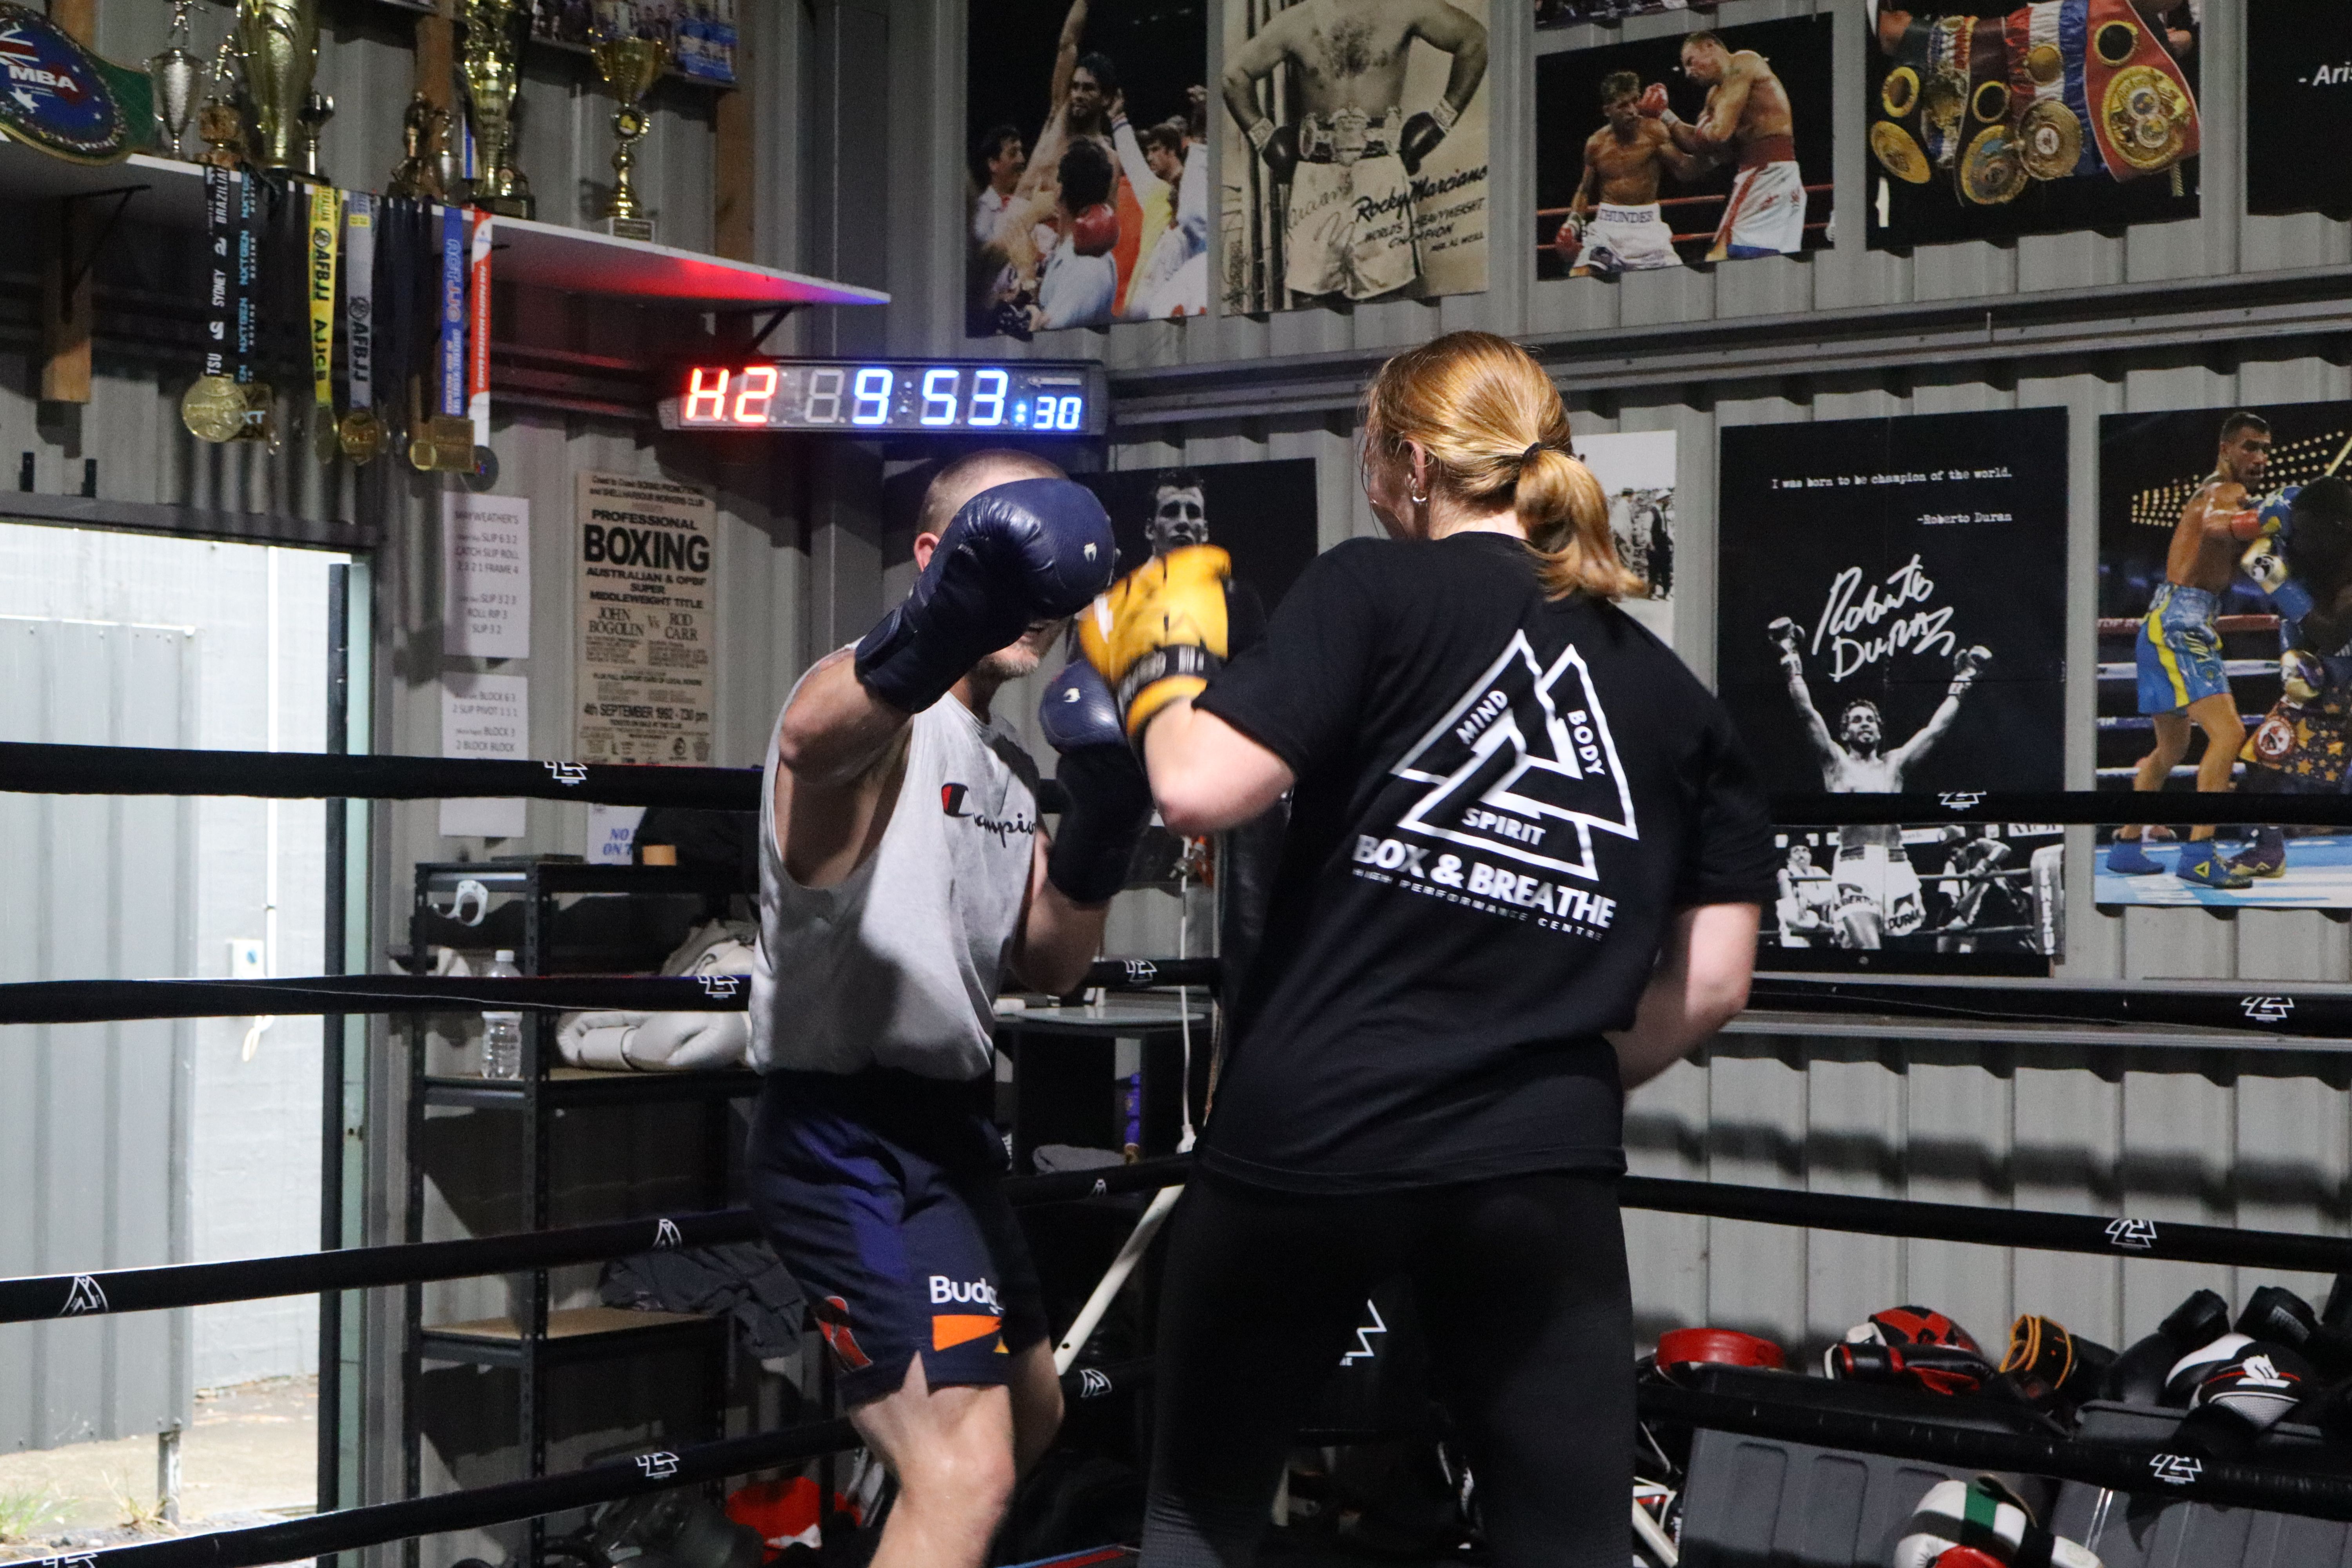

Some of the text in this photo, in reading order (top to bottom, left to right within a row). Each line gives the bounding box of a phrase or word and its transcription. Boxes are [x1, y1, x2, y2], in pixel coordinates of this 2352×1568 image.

[1772, 479, 1778, 489] I
[1782, 479, 1802, 488] was
[1807, 476, 1833, 487] born
[1838, 476, 1850, 486] to
[1854, 474, 1867, 485] be
[1871, 472, 1927, 486] champion
[1930, 470, 1944, 481] of
[1949, 469, 1970, 480] the
[592, 509, 698, 531] PROFESSIONAL
[1974, 512, 2013, 522] Duran
[584, 524, 710, 572] BOXING
[586, 567, 662, 582] AUSTRALIAN
[673, 597, 704, 609] TITLE
[1456, 691, 1508, 744] MIND
[1568, 710, 1605, 775] BODY
[941, 782, 1036, 848] Campio
[1462, 808, 1546, 845] SPIRIT
[1352, 834, 1617, 929] BOX & BREATHE
[1399, 879, 1528, 921] PERFORMANCE
[1538, 917, 1604, 941] CENTRE
